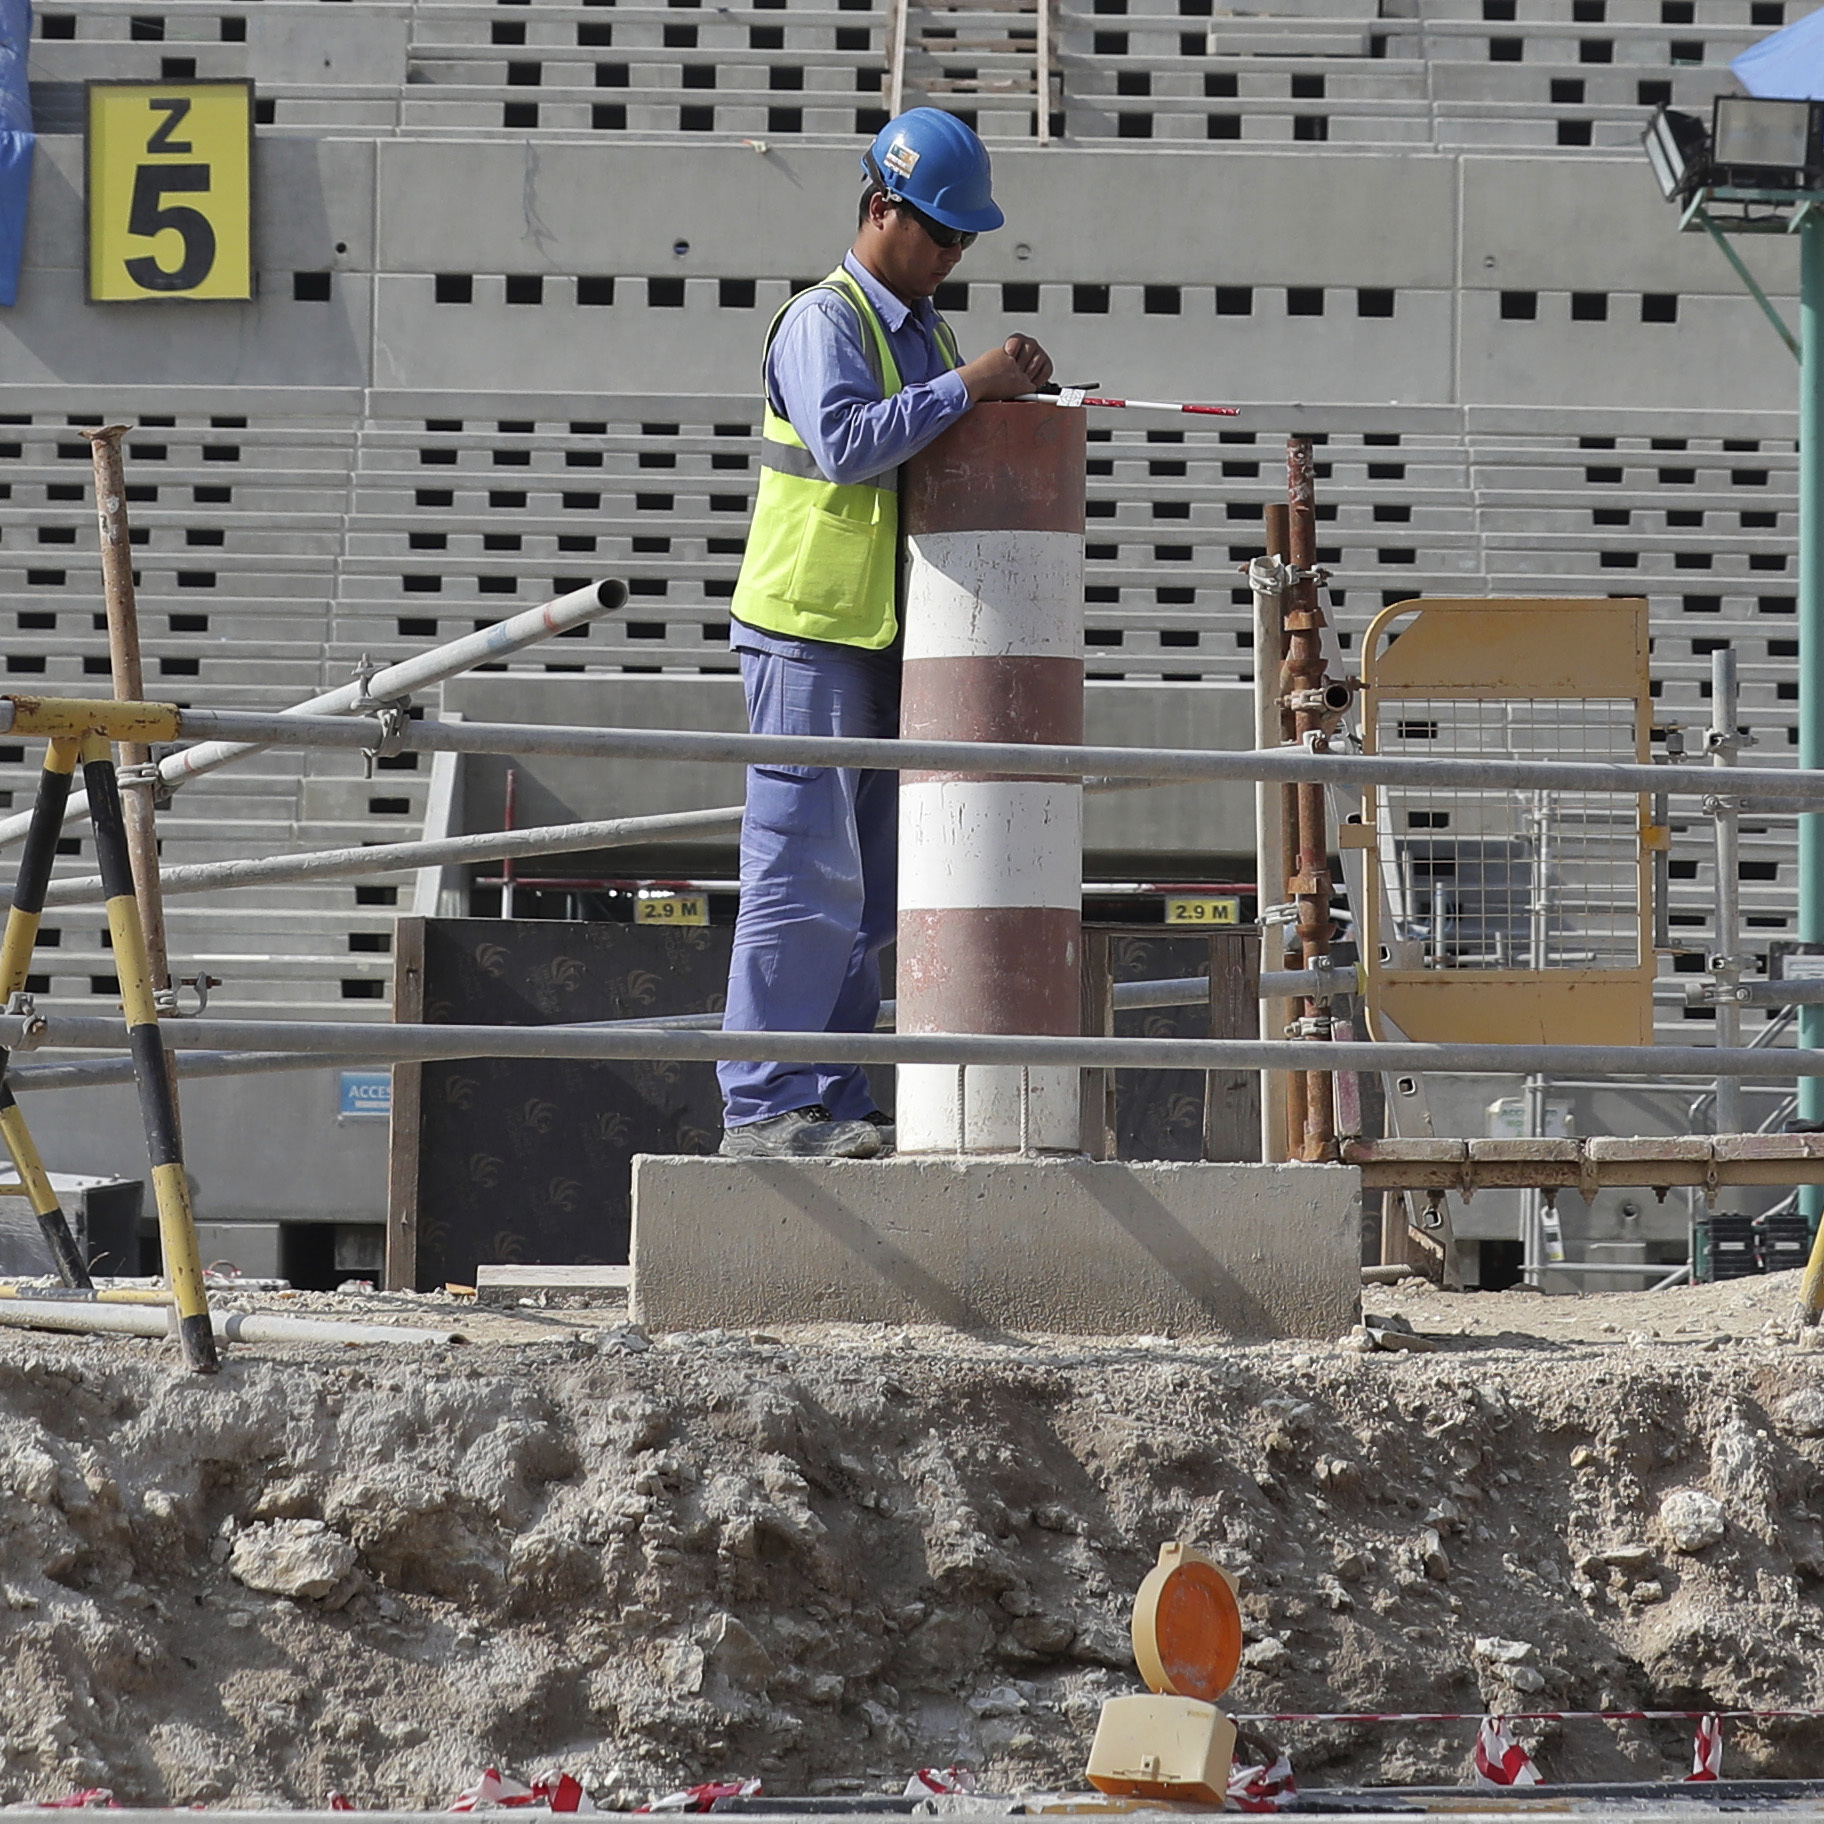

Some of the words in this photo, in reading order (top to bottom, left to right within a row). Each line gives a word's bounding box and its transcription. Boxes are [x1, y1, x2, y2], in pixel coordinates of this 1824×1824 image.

[147, 98, 192, 153] Z
[123, 163, 217, 291] 5
[644, 903, 674, 918] 2.9
[681, 902, 698, 916] M
[1175, 904, 1205, 919] 2.9
[1212, 905, 1228, 919] M
